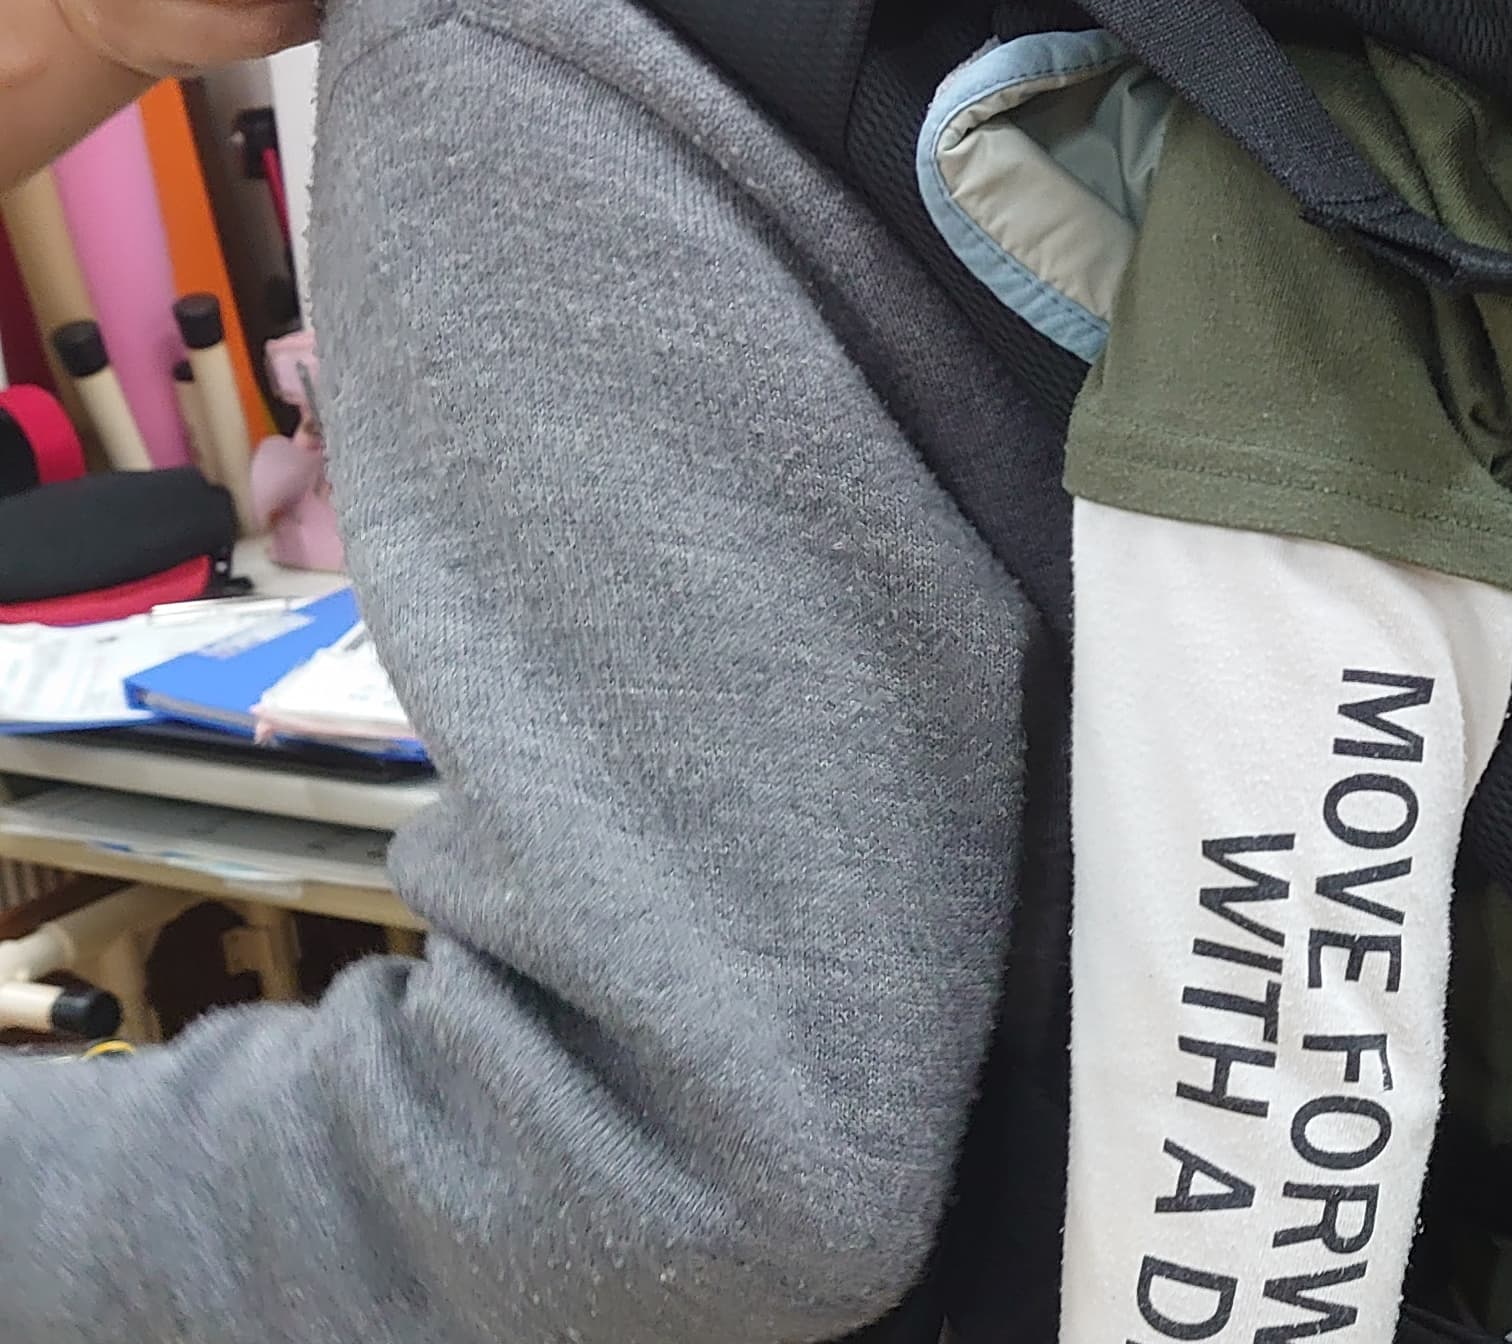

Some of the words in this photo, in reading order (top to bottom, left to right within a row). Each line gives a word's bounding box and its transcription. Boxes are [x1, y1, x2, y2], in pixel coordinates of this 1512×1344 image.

[1307, 668, 1436, 994] MOVE
[1175, 832, 1297, 1119] WITH
[1154, 1138, 1256, 1215] A
